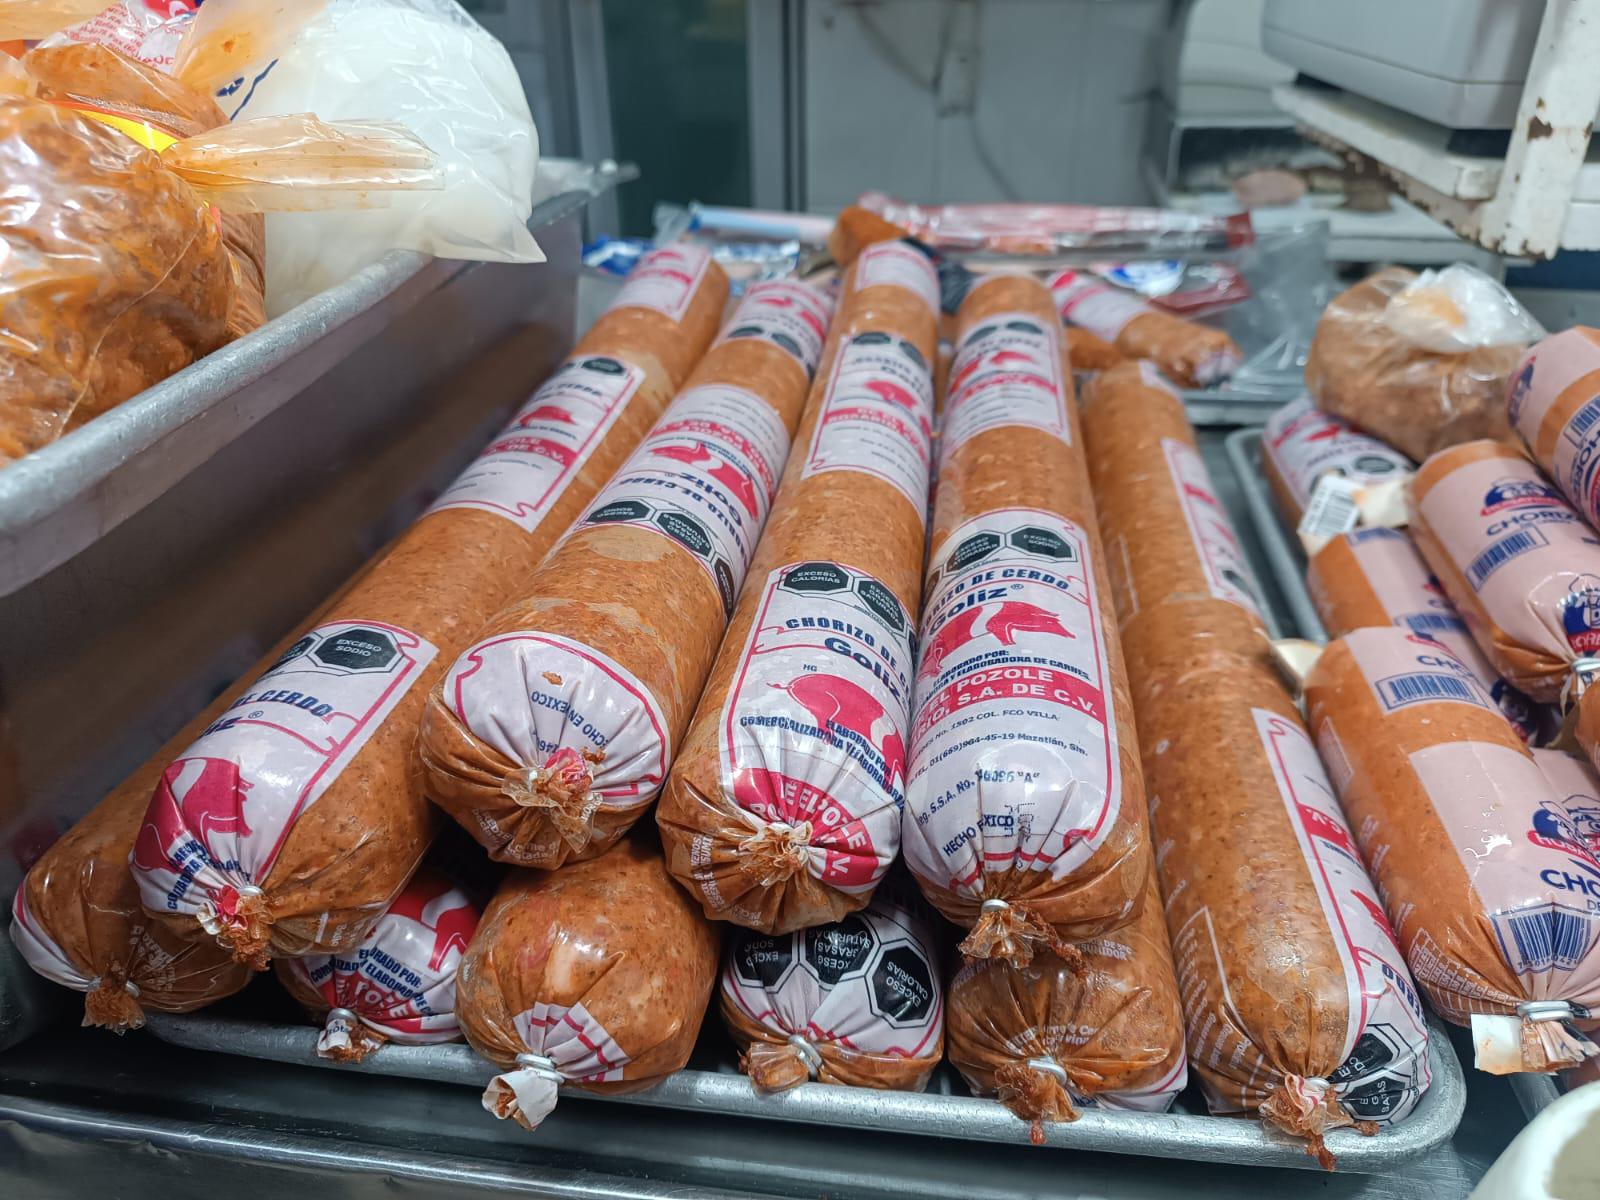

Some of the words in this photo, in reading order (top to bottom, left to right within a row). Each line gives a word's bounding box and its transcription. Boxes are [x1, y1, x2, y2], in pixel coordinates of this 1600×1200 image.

[971, 571, 995, 586] DE
[1002, 568, 1069, 590] CERDO
[335, 645, 372, 657] SODIO
[336, 638, 382, 652] EXCESO
[786, 617, 875, 647] CHORIZO
[881, 644, 897, 671] DE
[824, 637, 902, 702] Goliz
[933, 652, 983, 687] ELABORADO
[984, 649, 1009, 660] POR:
[956, 656, 1032, 679] ELABORADORA
[1033, 657, 1048, 665] DE
[956, 668, 1053, 692] POZOLE
[257, 689, 333, 717] CERDO
[957, 686, 1002, 706] S.A.
[1012, 683, 1045, 696] DE
[1054, 689, 1097, 716] C.V.
[1027, 709, 1058, 720] VILLA
[826, 719, 876, 760] ELABORADO
[930, 791, 957, 815] S.S.A.
[956, 777, 976, 794] No.
[943, 826, 977, 857] HECHO
[398, 968, 422, 989] POR:
[886, 975, 921, 1008] EXCESO
[887, 960, 929, 1000] CALORÍAS
